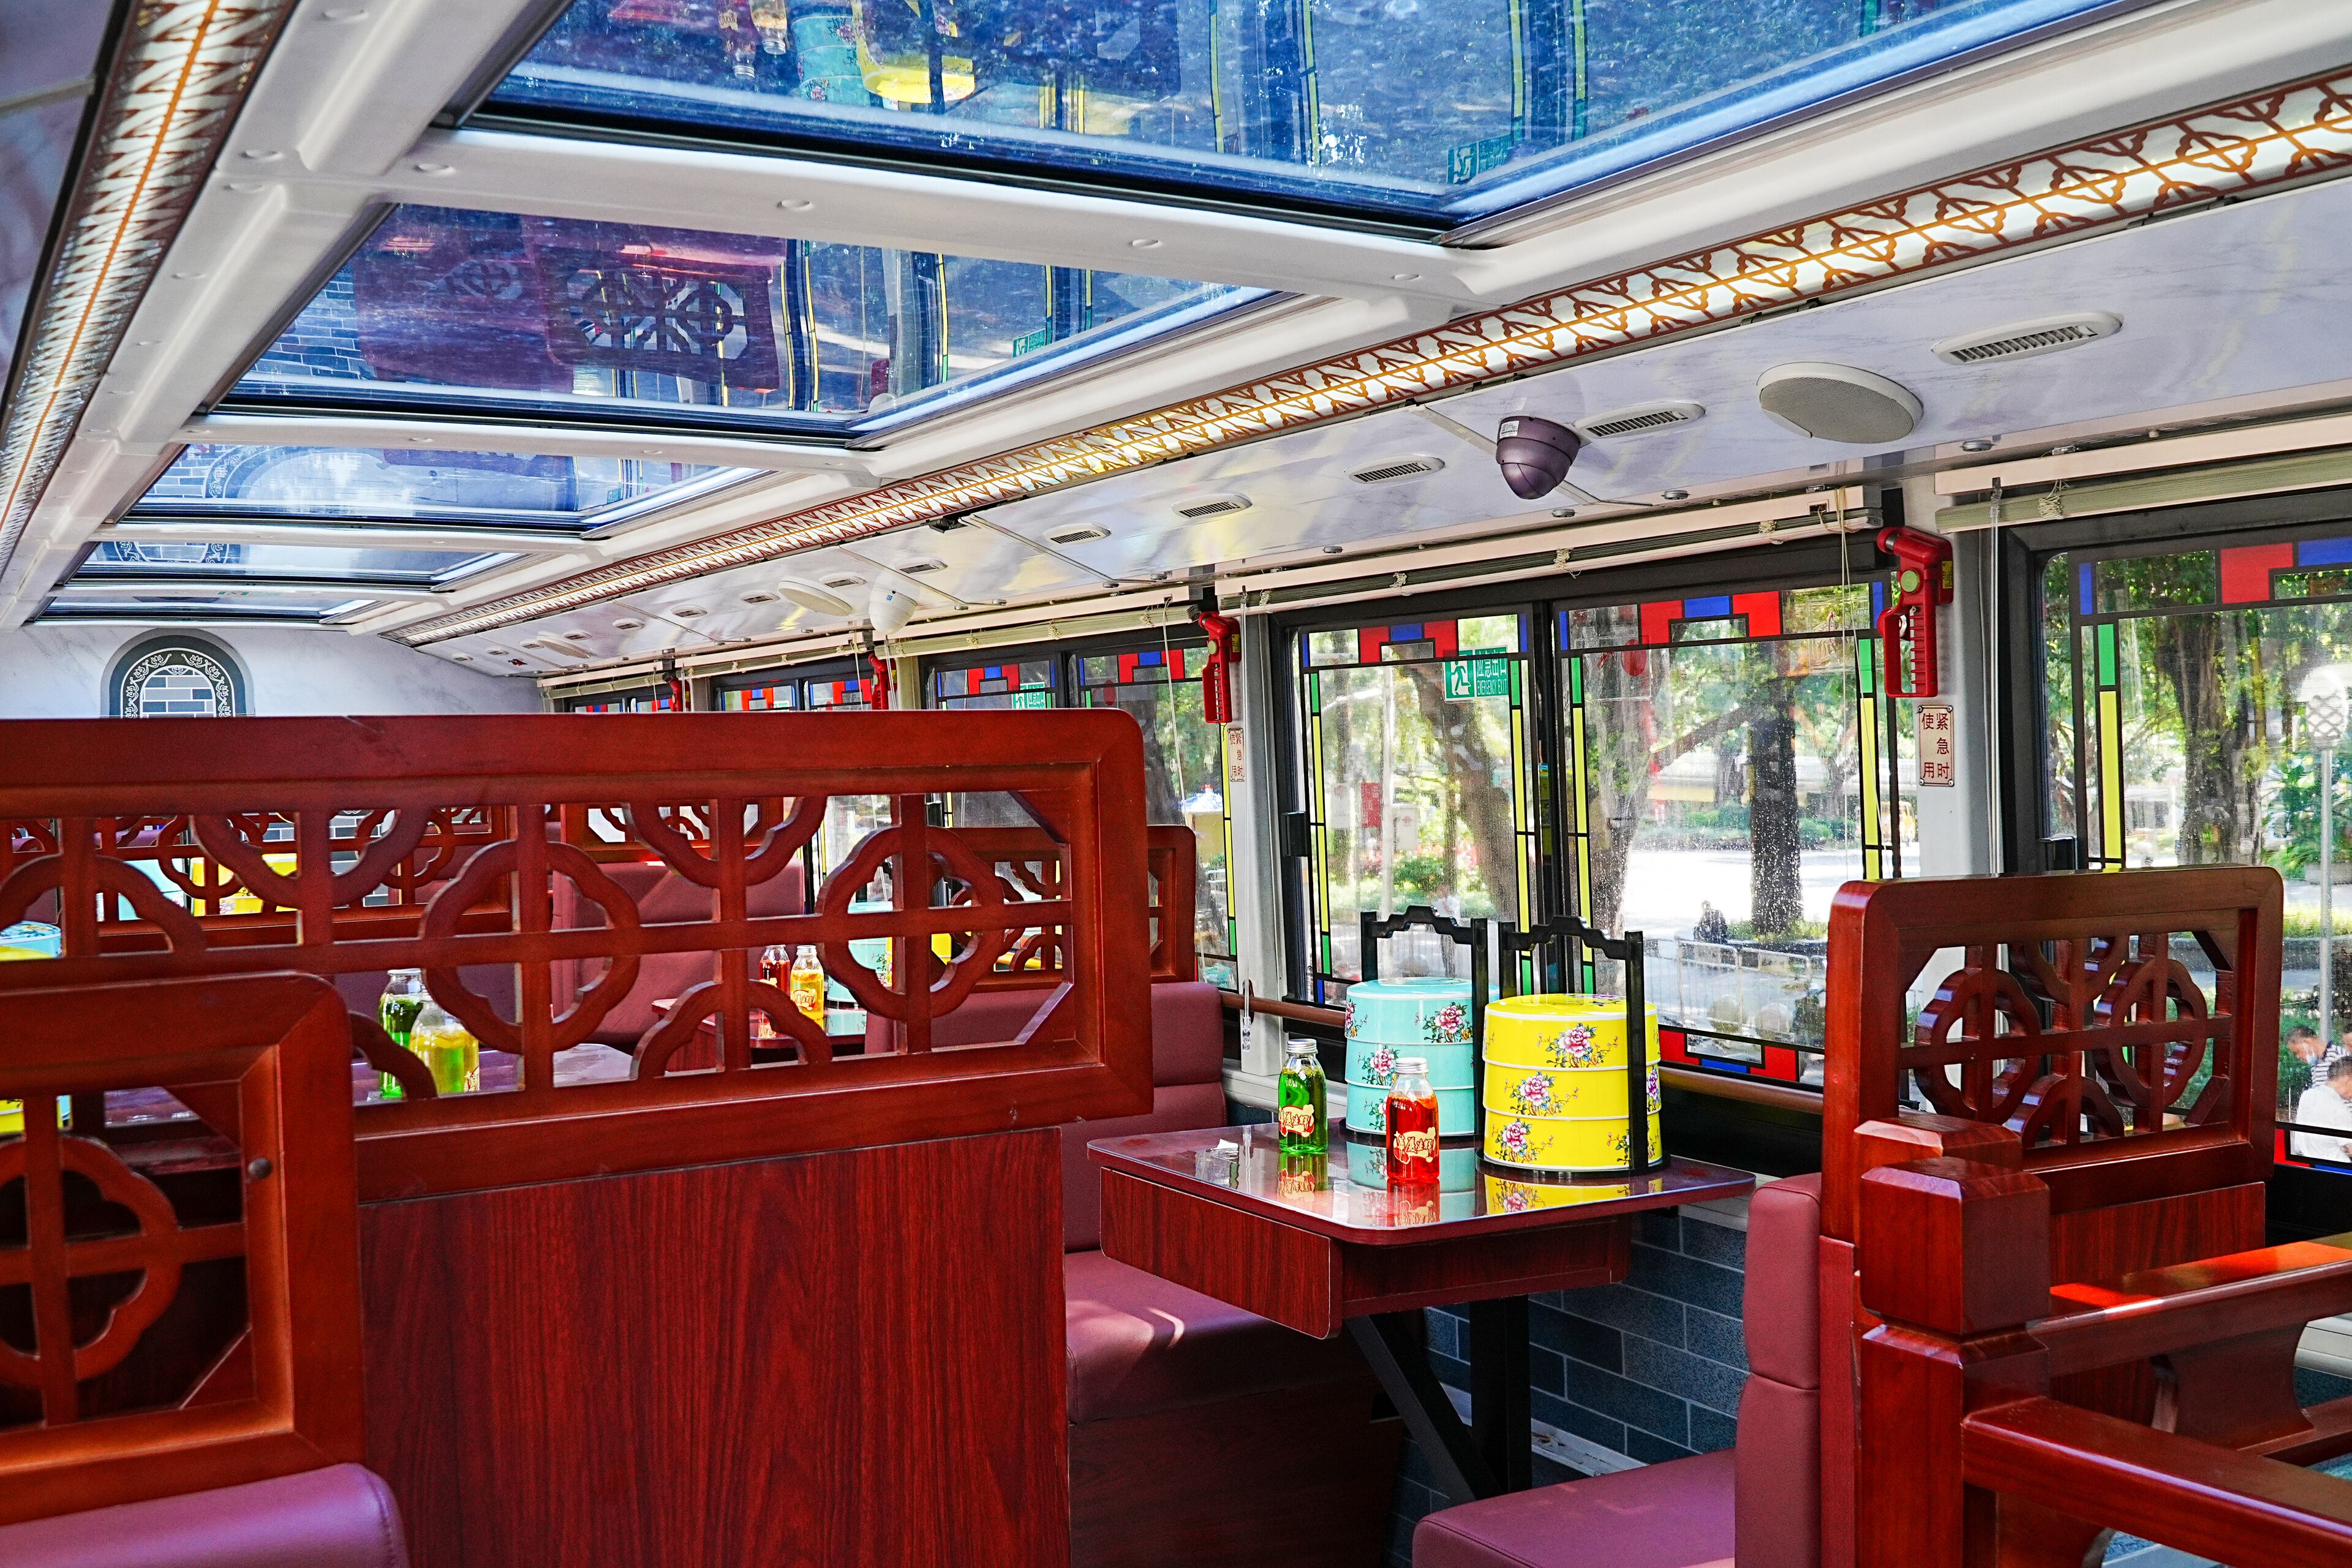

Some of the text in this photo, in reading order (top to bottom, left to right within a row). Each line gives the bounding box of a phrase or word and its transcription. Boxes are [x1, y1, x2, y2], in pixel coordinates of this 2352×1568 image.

[1477, 649, 1507, 678] 应急出口
[1477, 678, 1507, 696] EMERGENCY EXIT
[1921, 712, 1935, 779] 使用
[1936, 712, 1950, 779] 紧急时
